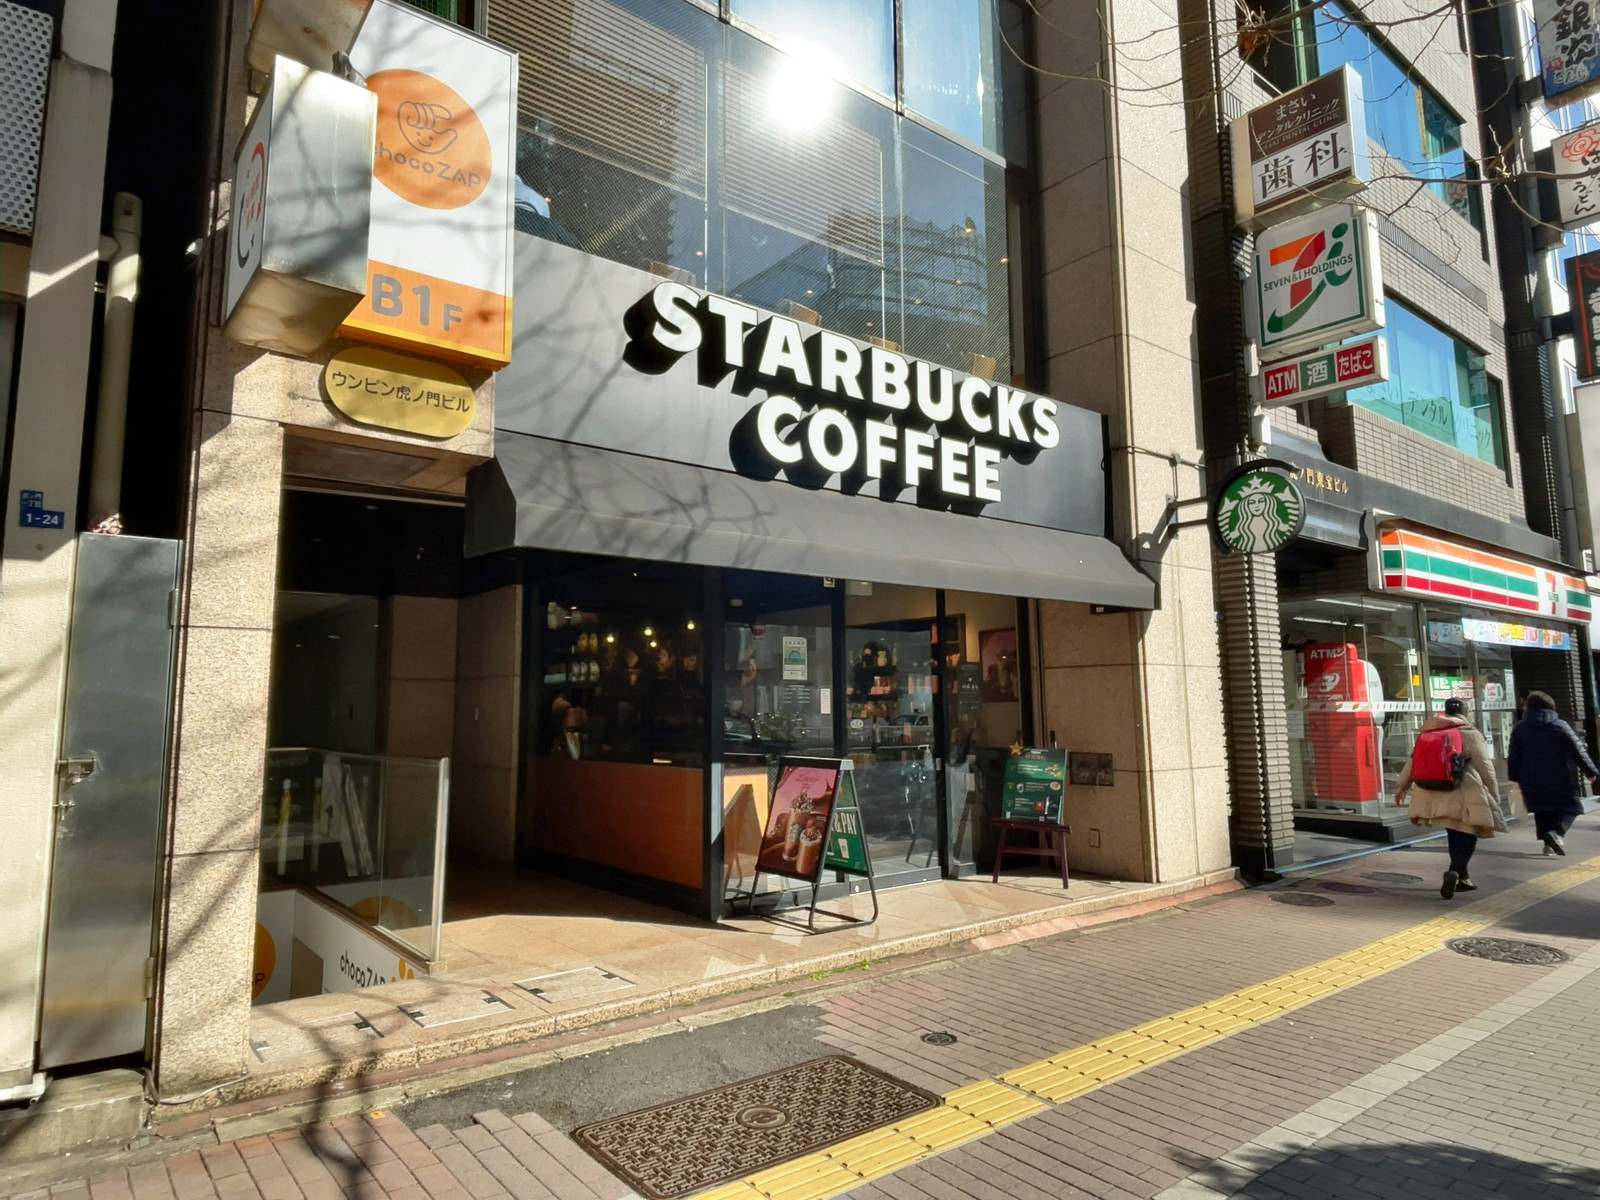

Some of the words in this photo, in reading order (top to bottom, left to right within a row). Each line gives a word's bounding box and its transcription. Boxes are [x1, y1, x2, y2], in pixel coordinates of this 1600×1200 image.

[1257, 98, 1340, 140] デンタルクリニック
[1276, 93, 1317, 121] まさい
[375, 141, 481, 187] hocoZAP
[1258, 131, 1348, 200] 歯科
[1572, 181, 1597, 215] うどん
[1303, 253, 1354, 281] HOLDINGS
[370, 273, 463, 332] B1F
[651, 280, 1061, 450] STARBUCKS
[1307, 359, 1329, 386] 酒
[1338, 350, 1374, 376] たばこ
[331, 371, 471, 413] ウンピン虎ノ門ビル
[1267, 369, 1297, 396] ATM
[756, 395, 1002, 502] COFFEE
[26, 512, 59, 525] 1-24
[1310, 648, 1337, 660] ATM
[841, 812, 858, 835] PAY
